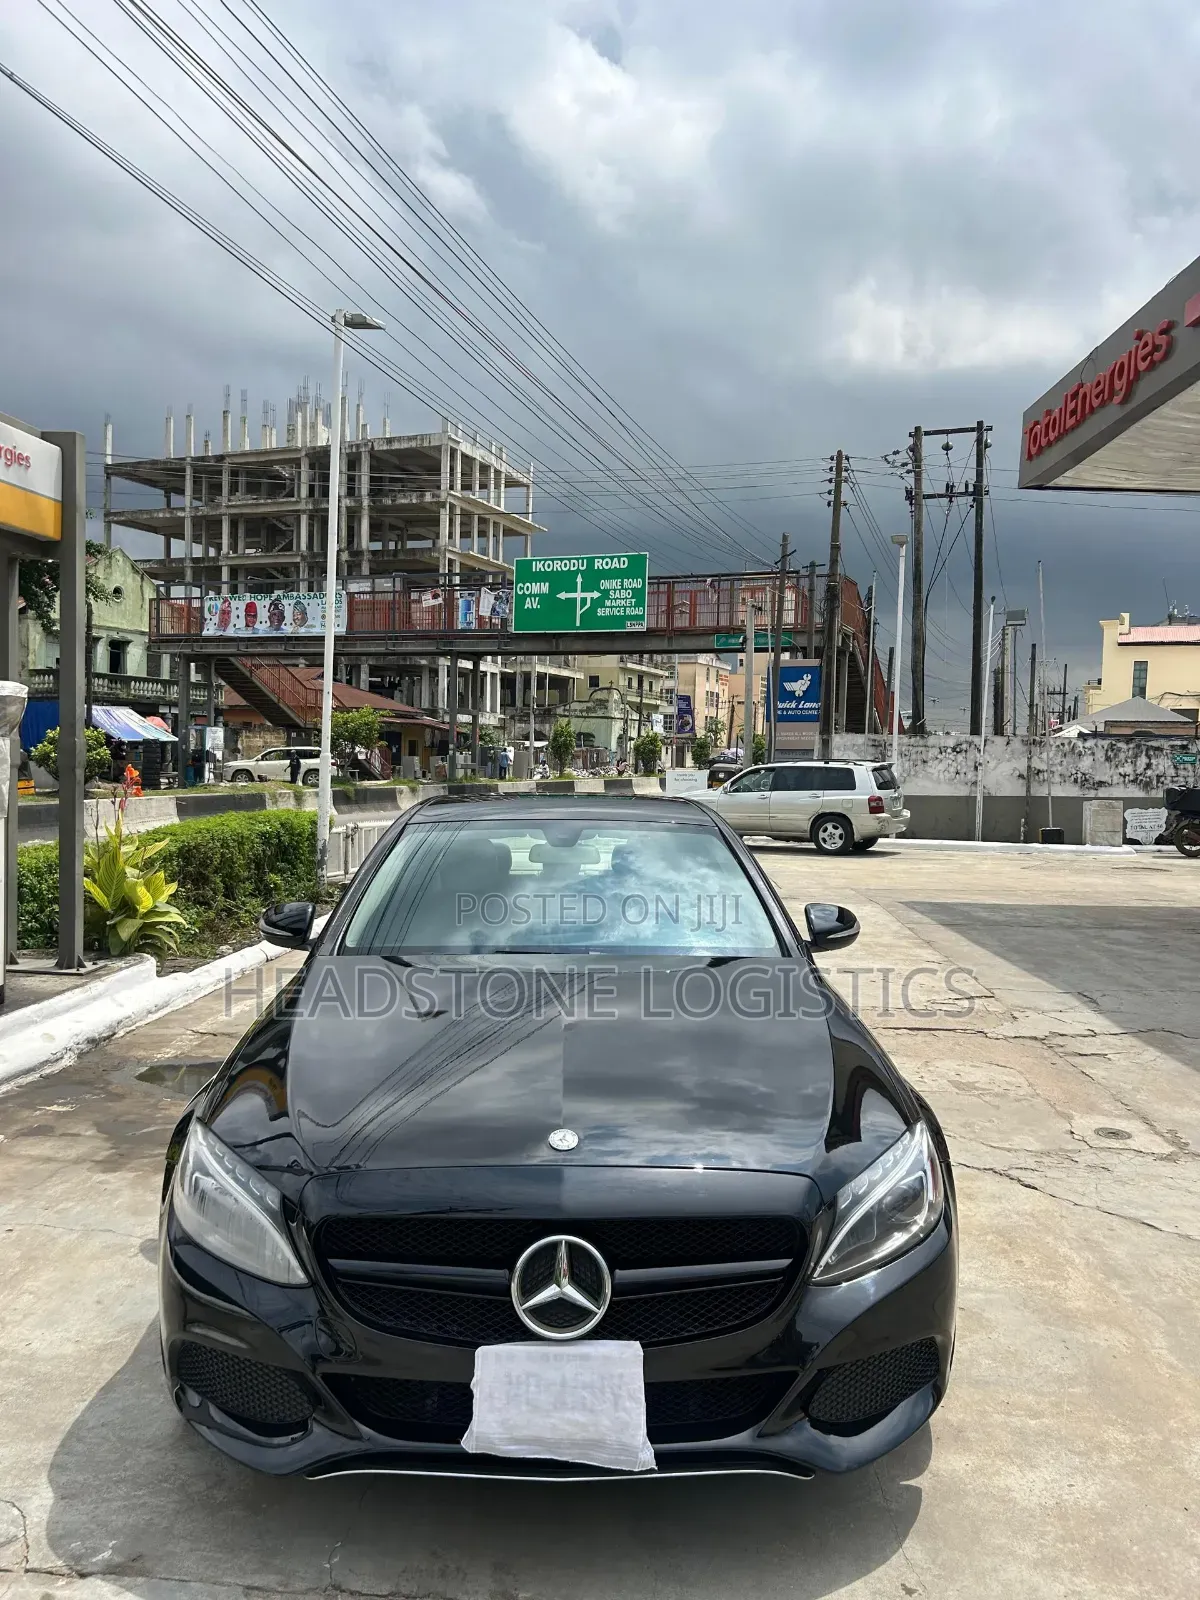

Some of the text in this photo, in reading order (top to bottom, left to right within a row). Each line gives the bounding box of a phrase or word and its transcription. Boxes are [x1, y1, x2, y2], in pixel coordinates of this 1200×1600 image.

[1024, 319, 1175, 461] TotalEnergies
[532, 557, 629, 572] IKORODU ROAD
[517, 582, 549, 595] COMM
[600, 578, 643, 590] ONIKE ROAD
[609, 590, 632, 599] SABO
[524, 597, 541, 609] AV.
[604, 599, 636, 607] MARKET
[597, 606, 644, 616] SERVICE ROAD
[777, 700, 798, 709] uick
